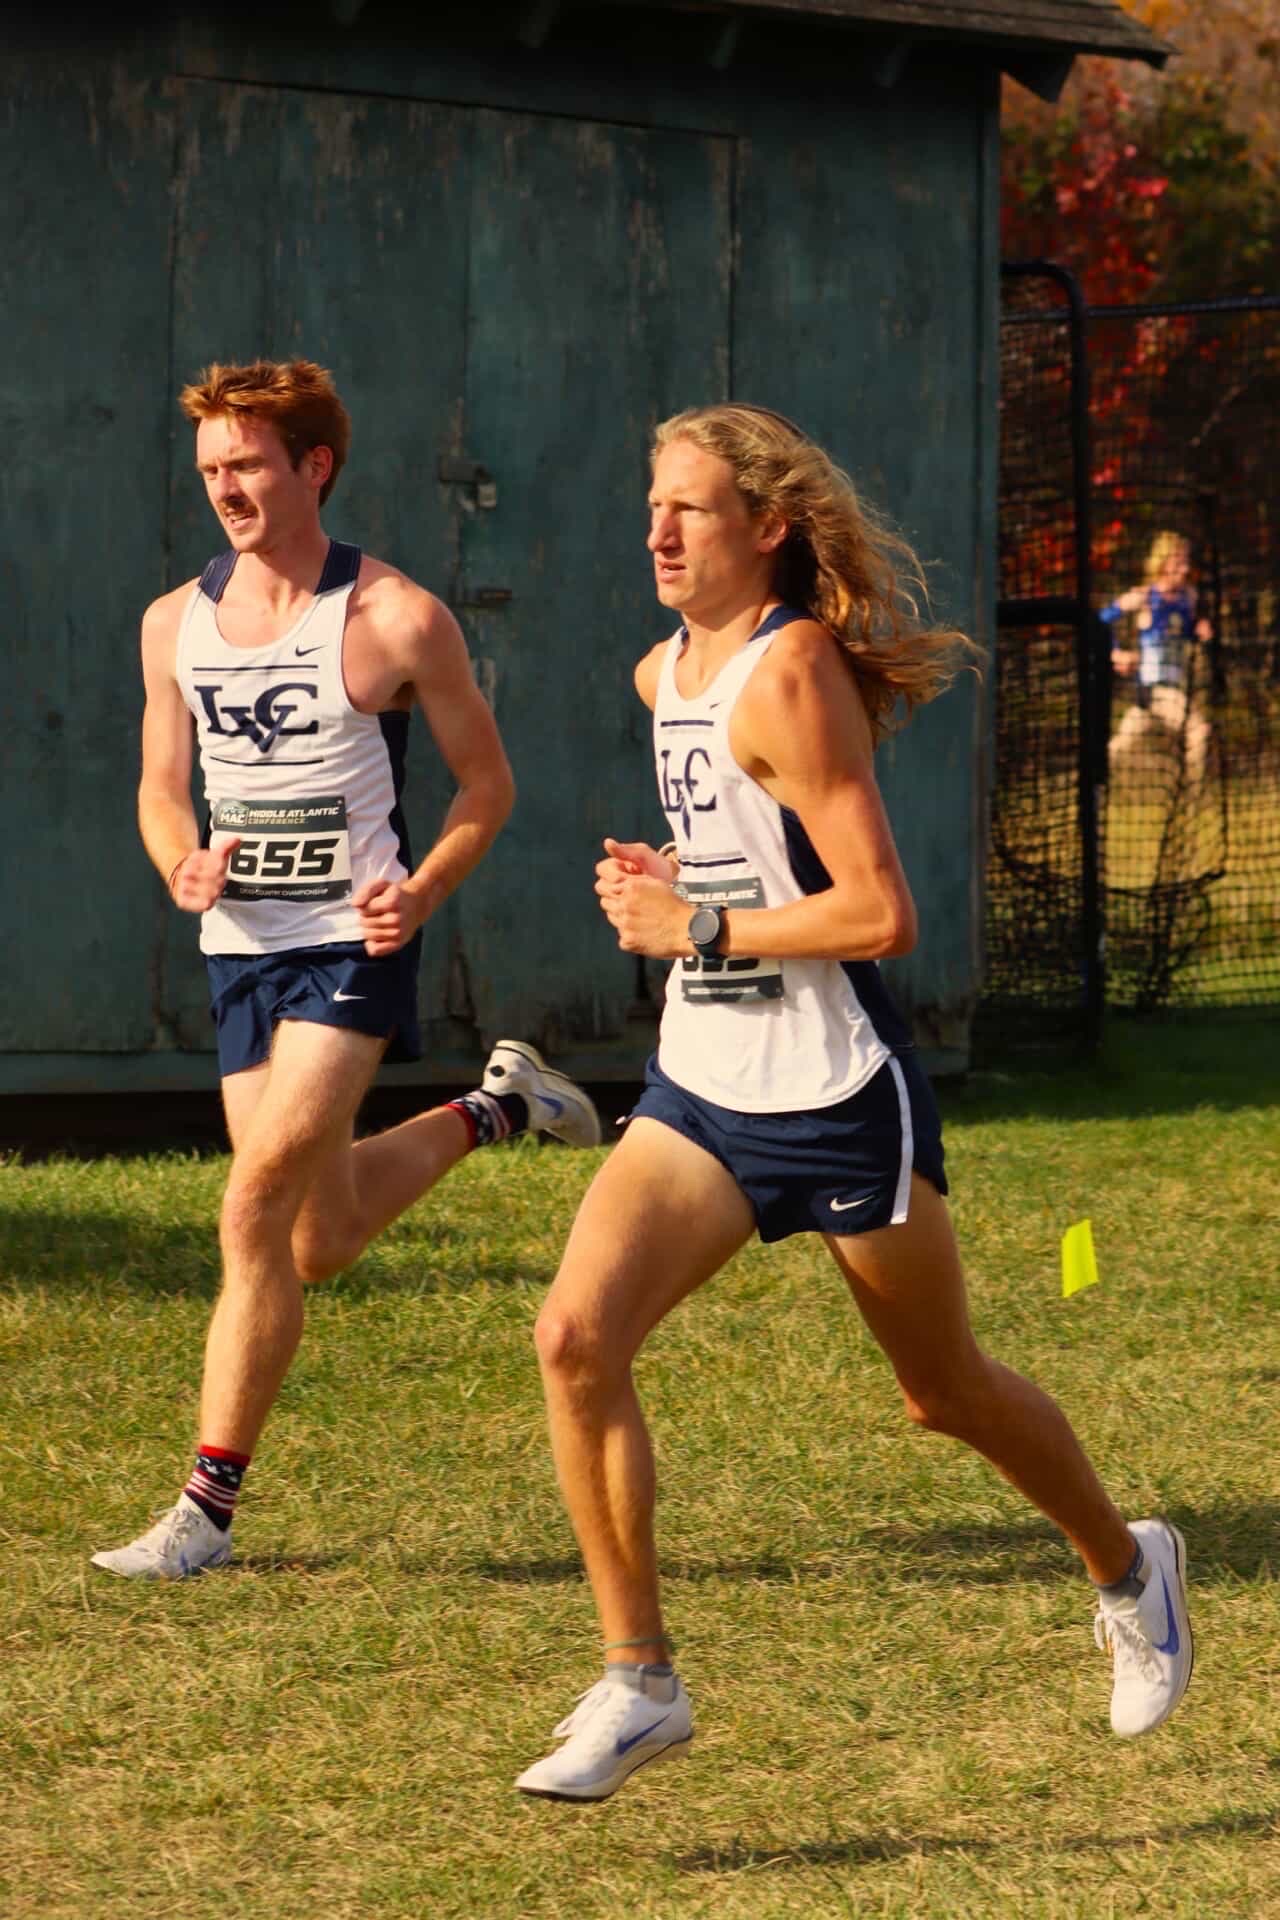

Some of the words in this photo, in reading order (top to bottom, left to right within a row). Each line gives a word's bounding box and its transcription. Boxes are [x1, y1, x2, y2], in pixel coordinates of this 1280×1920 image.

[248, 809, 286, 818] MIDDLE
[286, 806, 340, 818] ATLANTIC
[219, 813, 246, 824] MAC
[229, 838, 341, 877] 655
